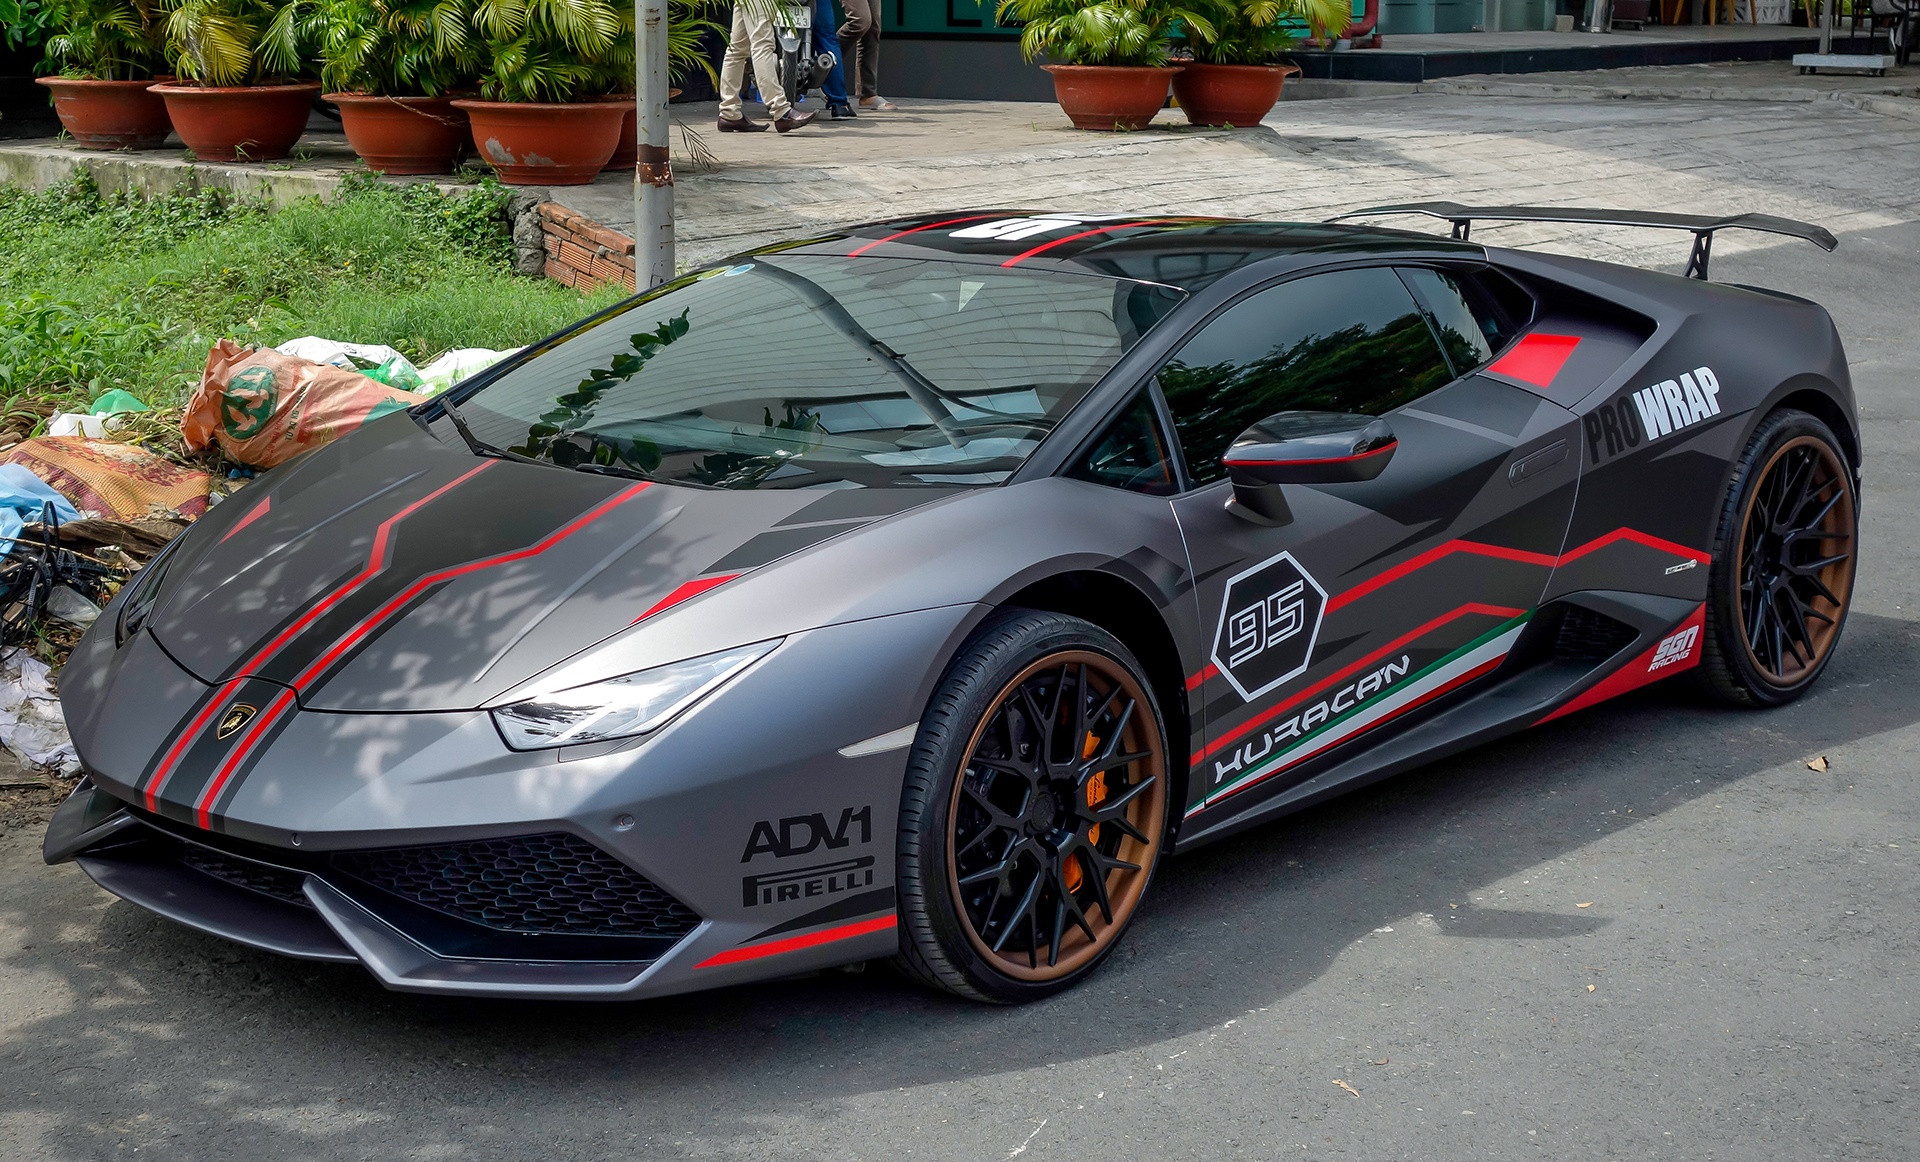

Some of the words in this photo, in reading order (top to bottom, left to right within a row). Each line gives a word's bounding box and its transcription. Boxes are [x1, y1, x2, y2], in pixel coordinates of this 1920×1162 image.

[1229, 579, 1304, 669] 95
[1647, 648, 1691, 673] RACING
[742, 855, 875, 908] PIRELLI
